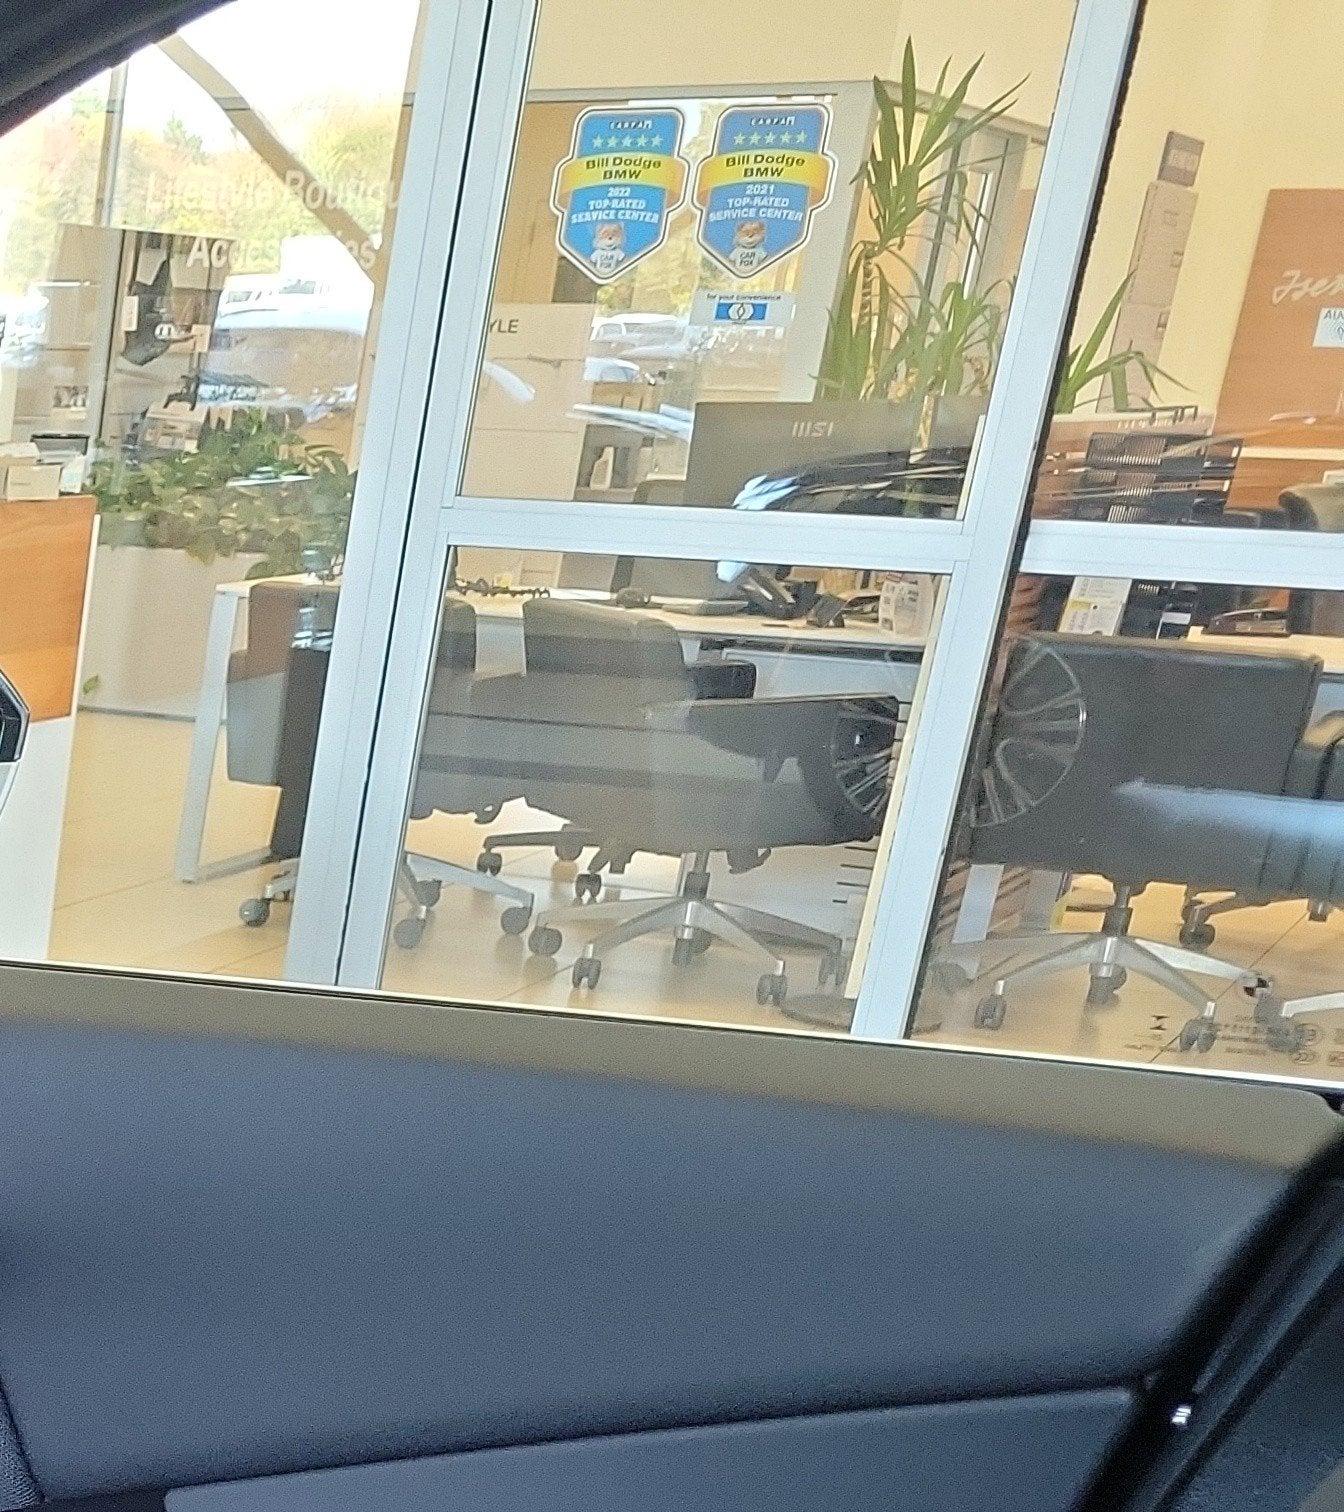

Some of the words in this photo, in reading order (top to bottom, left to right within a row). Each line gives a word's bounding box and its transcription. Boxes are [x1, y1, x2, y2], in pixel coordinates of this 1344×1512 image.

[585, 157, 609, 170] Bill
[612, 156, 662, 169] Dodge
[725, 155, 750, 167] Bill
[753, 154, 806, 167] Dodge
[602, 169, 642, 180] BMW
[743, 167, 785, 178] BMW
[745, 184, 775, 195] 2021
[587, 199, 647, 210] TOP-RATED
[727, 196, 790, 208] TOP-RATED
[571, 210, 616, 224] SERVICE
[617, 210, 660, 224] CENTER
[708, 208, 756, 222] SERVICE
[758, 208, 804, 221] CENTER
